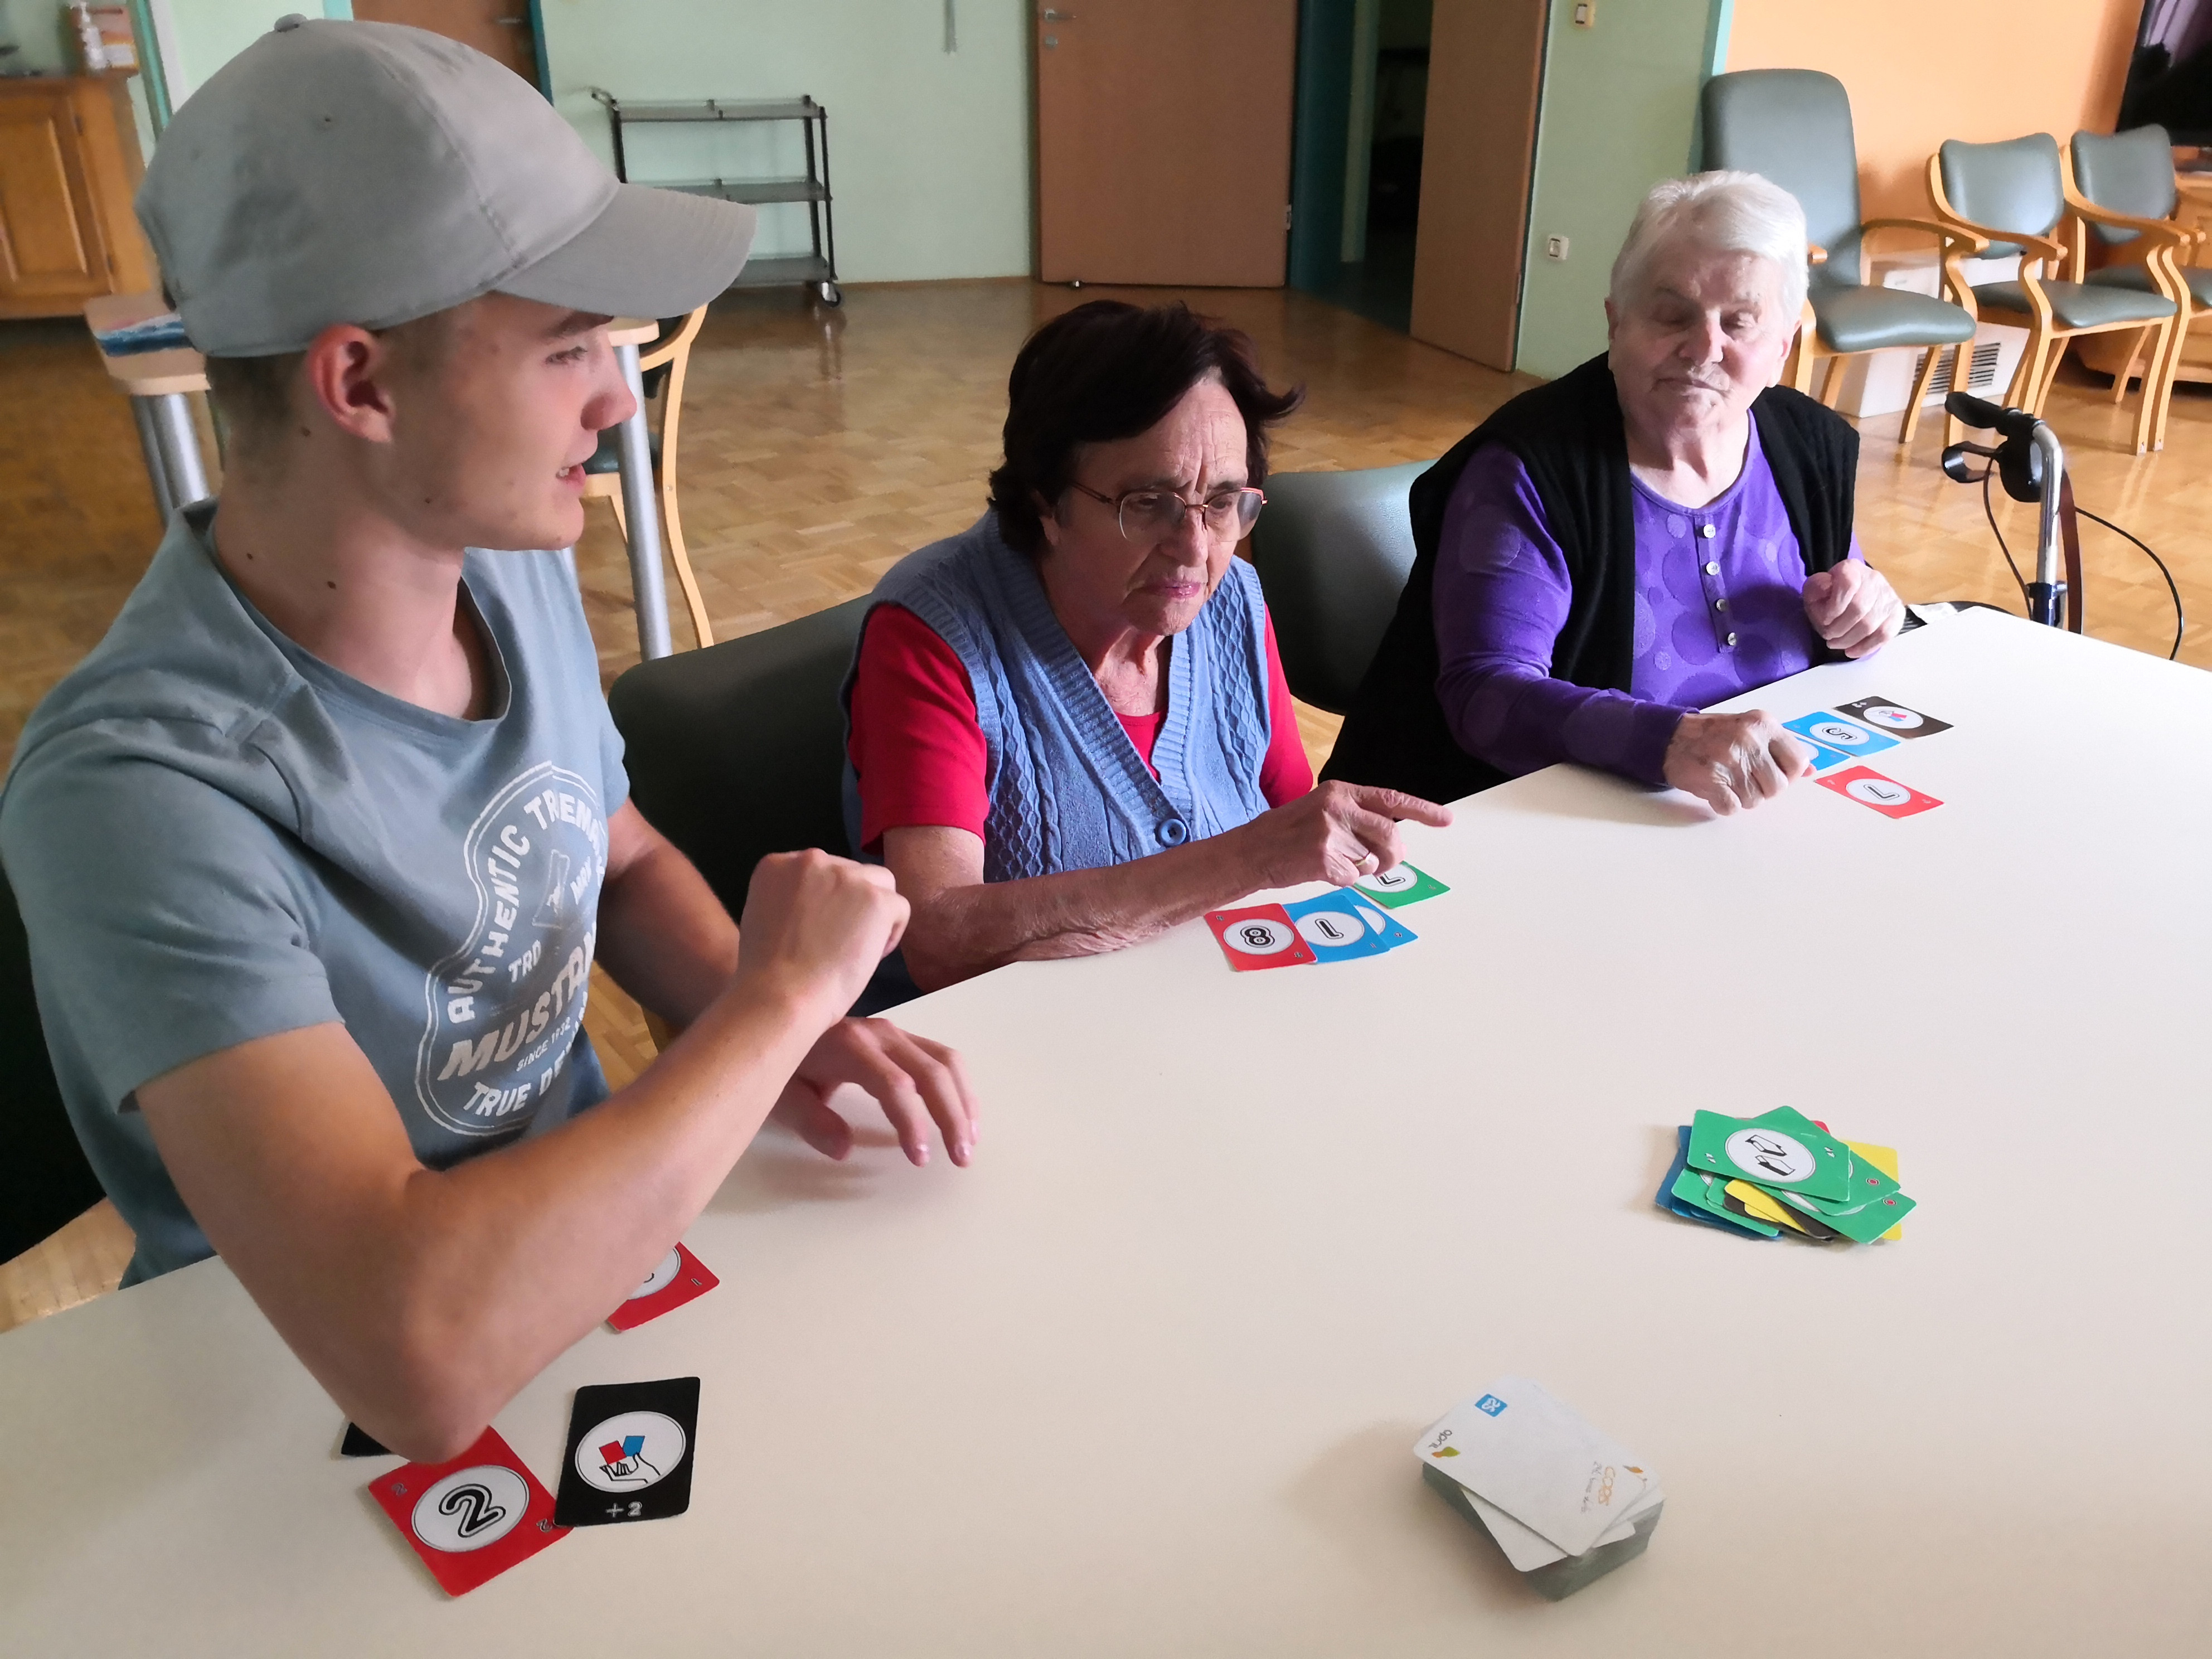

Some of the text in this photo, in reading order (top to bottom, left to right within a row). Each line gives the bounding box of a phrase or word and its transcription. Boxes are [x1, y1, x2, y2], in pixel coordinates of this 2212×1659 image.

[447, 824, 530, 1023] AUTHENTIC
[1240, 925, 1275, 948] 8
[508, 939, 541, 982] TRD
[516, 1040, 549, 1072] SINCE
[463, 1083, 531, 1117] TRUE
[438, 1483, 506, 1537] 2
